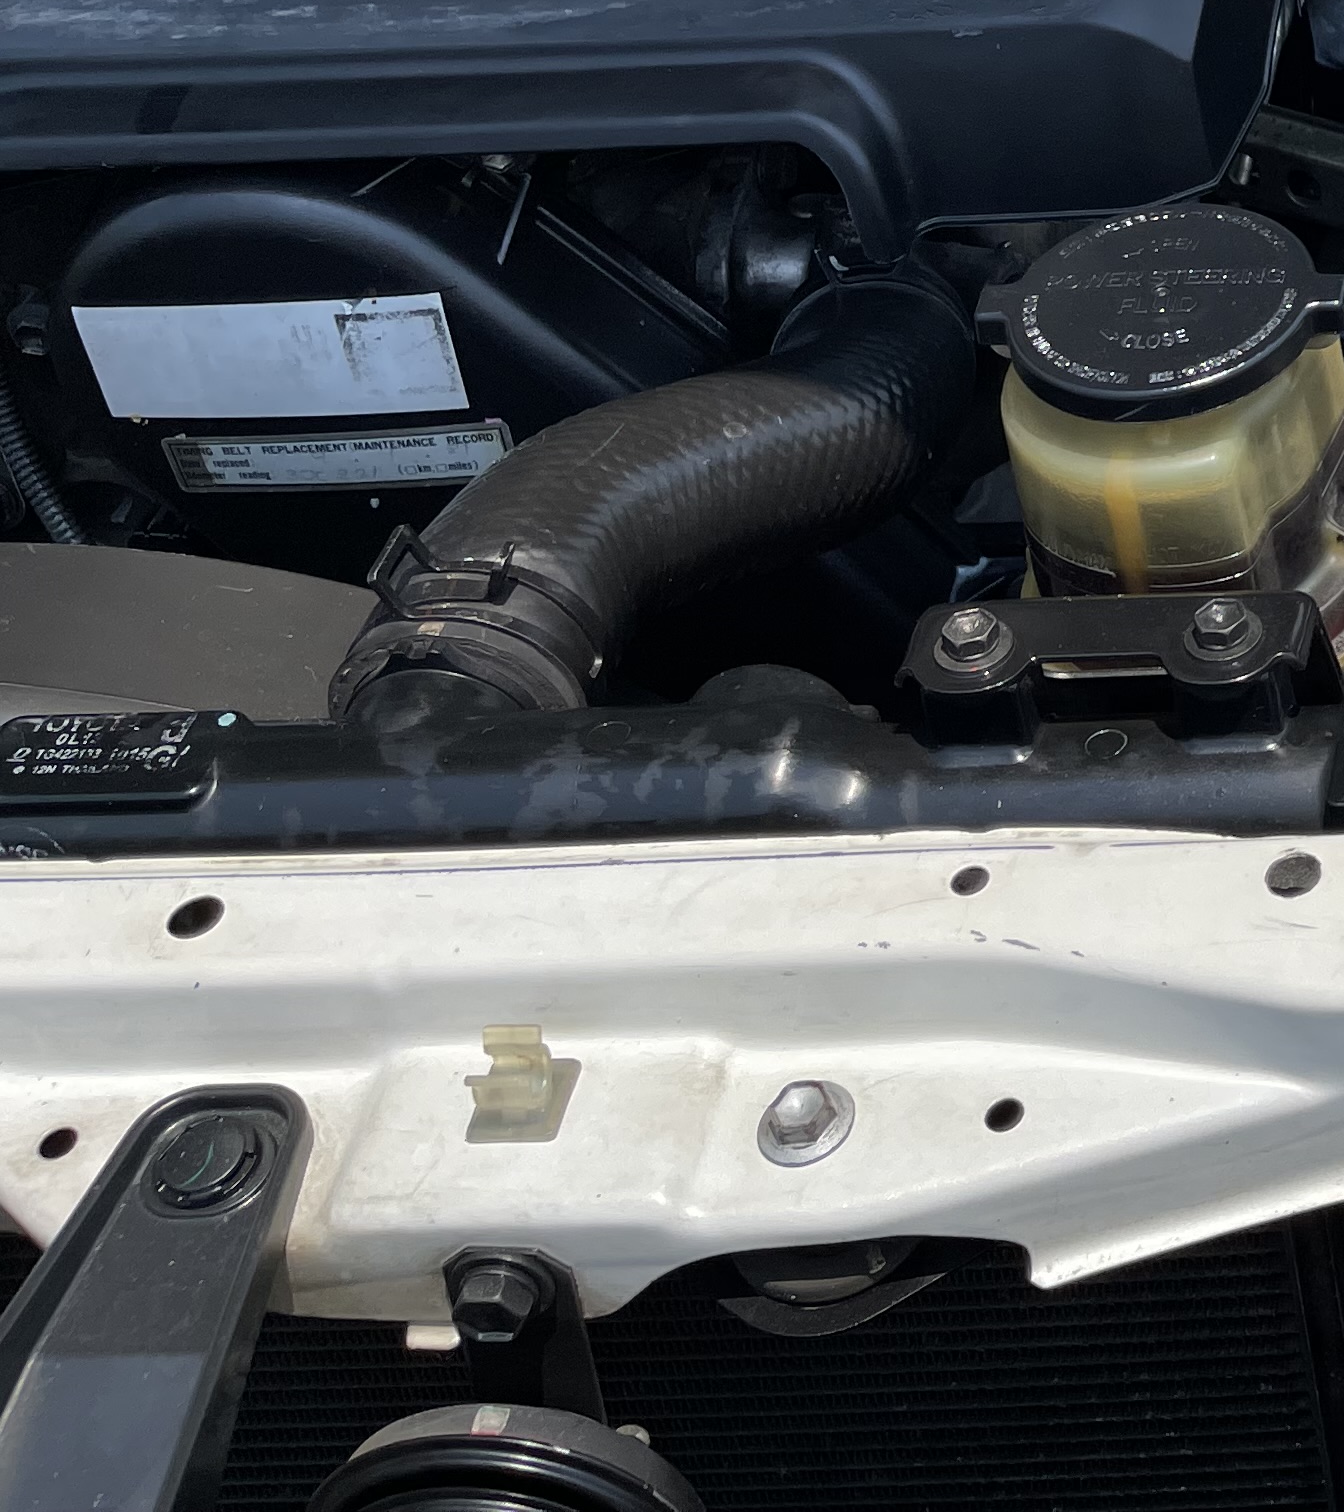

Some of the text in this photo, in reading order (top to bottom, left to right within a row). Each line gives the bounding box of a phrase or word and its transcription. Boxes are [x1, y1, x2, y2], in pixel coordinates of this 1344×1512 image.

[1045, 268, 1287, 291] POWER STEERING
[1117, 295, 1199, 315] FLUID
[1120, 328, 1191, 350] CLOSE
[221, 445, 252, 456] BELT
[261, 442, 348, 455] REPLACEMENT
